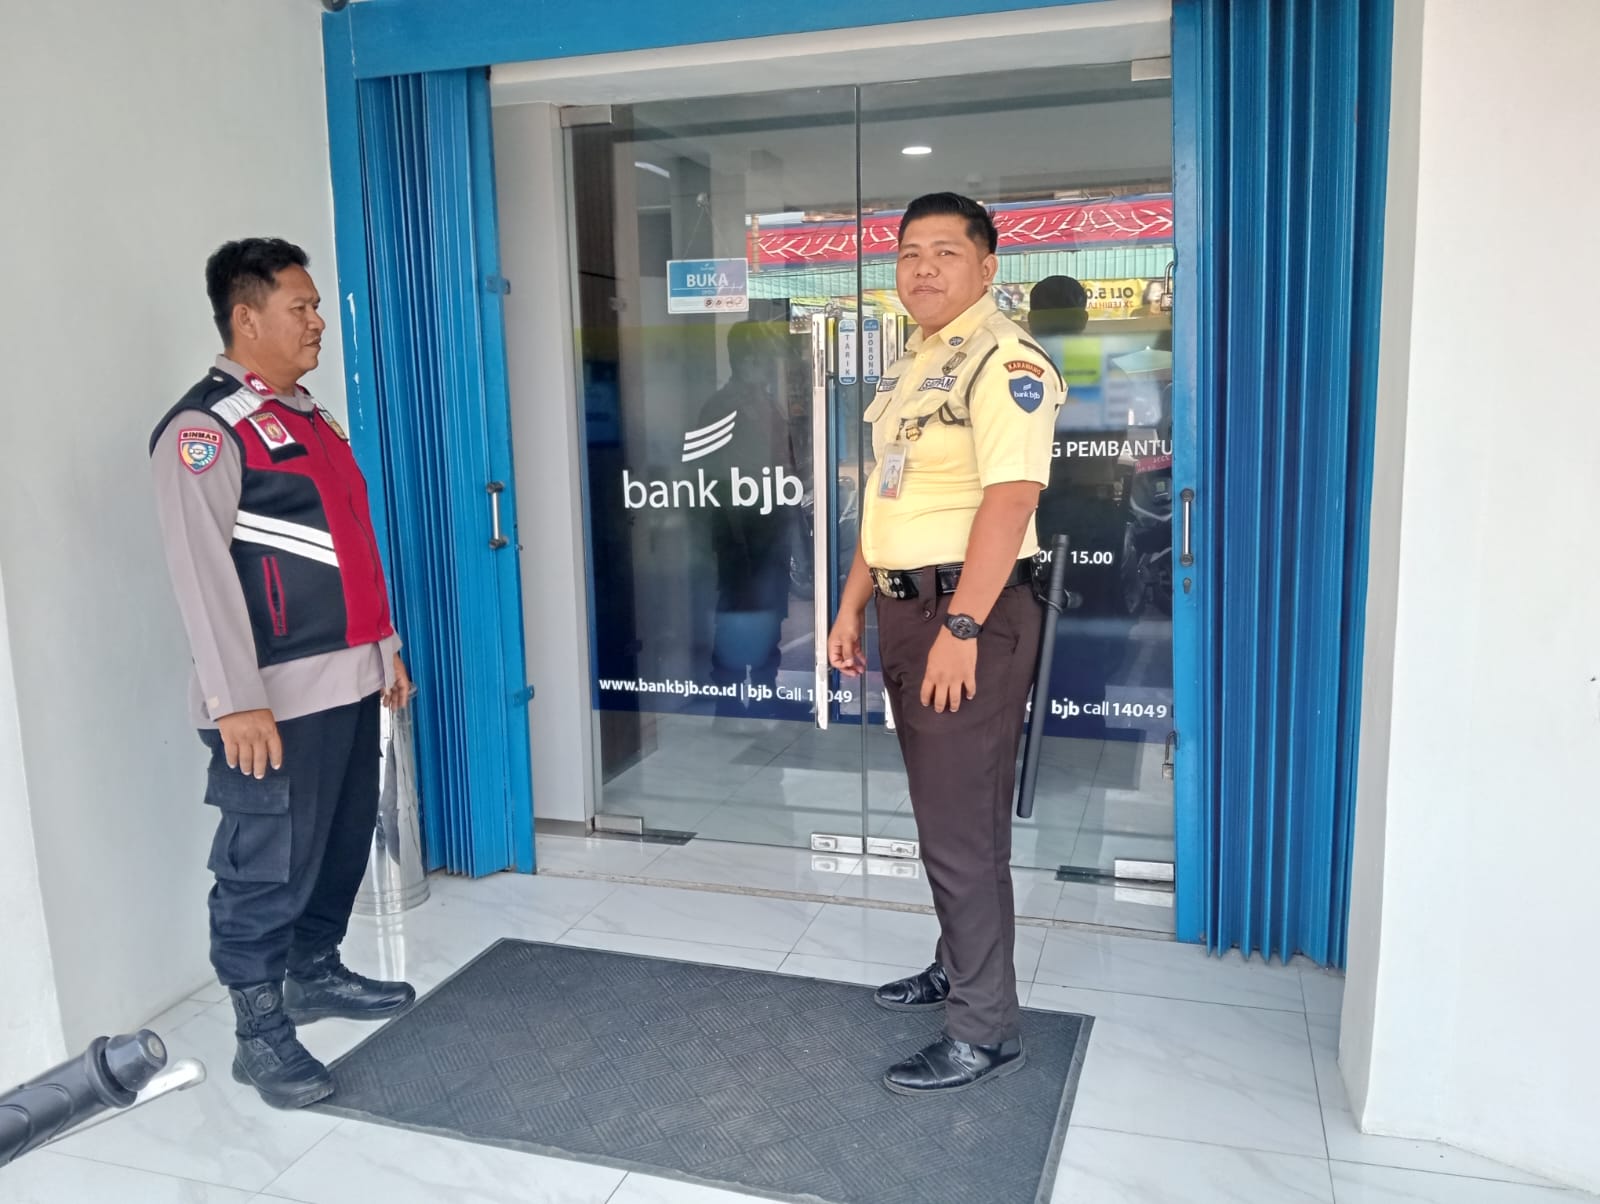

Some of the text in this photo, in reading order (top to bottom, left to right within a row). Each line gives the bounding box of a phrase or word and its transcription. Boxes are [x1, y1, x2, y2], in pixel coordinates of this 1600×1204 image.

[686, 273, 729, 287] BUKA
[1007, 362, 1042, 375] KARAWANG
[1029, 391, 1041, 400] bjb
[1066, 439, 1173, 458] PEMBANTU
[622, 466, 804, 515] bank bjb
[1070, 551, 1113, 565] 15.00
[599, 678, 737, 697] www.bankbjb.co.id
[747, 684, 773, 701] bjb
[776, 686, 802, 702] Call
[807, 688, 853, 703] 1049
[1051, 697, 1080, 719] bjb
[1112, 702, 1168, 719] 14049
